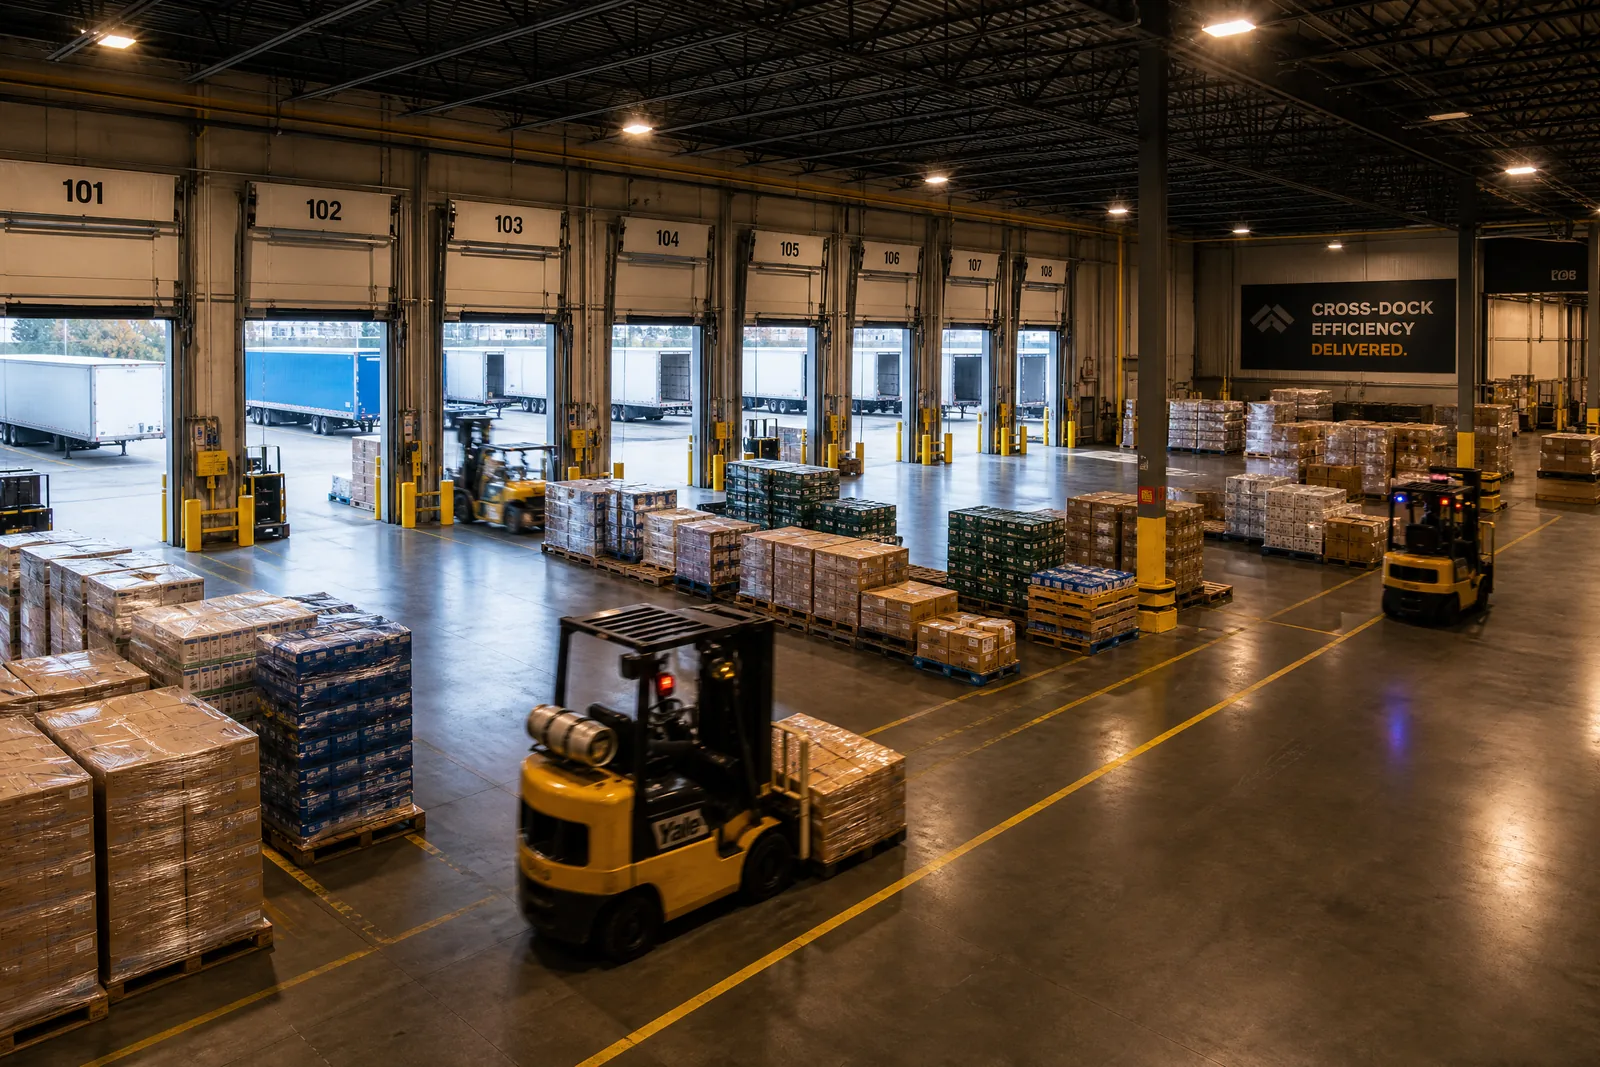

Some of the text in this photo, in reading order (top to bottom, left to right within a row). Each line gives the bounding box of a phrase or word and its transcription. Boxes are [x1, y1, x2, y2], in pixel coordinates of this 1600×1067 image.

[62, 178, 103, 205] 101
[306, 198, 342, 221] 102
[494, 214, 523, 235] 103
[656, 229, 680, 248] 104
[780, 241, 800, 258] 105
[884, 250, 900, 265] 106
[968, 258, 982, 272] 107
[1040, 265, 1053, 278] 108
[1311, 300, 1434, 316] CROSS-DOCK
[1311, 321, 1415, 336] EFFICIENCY
[1311, 343, 1408, 357] DELIVERED.
[659, 816, 701, 845] Yale
